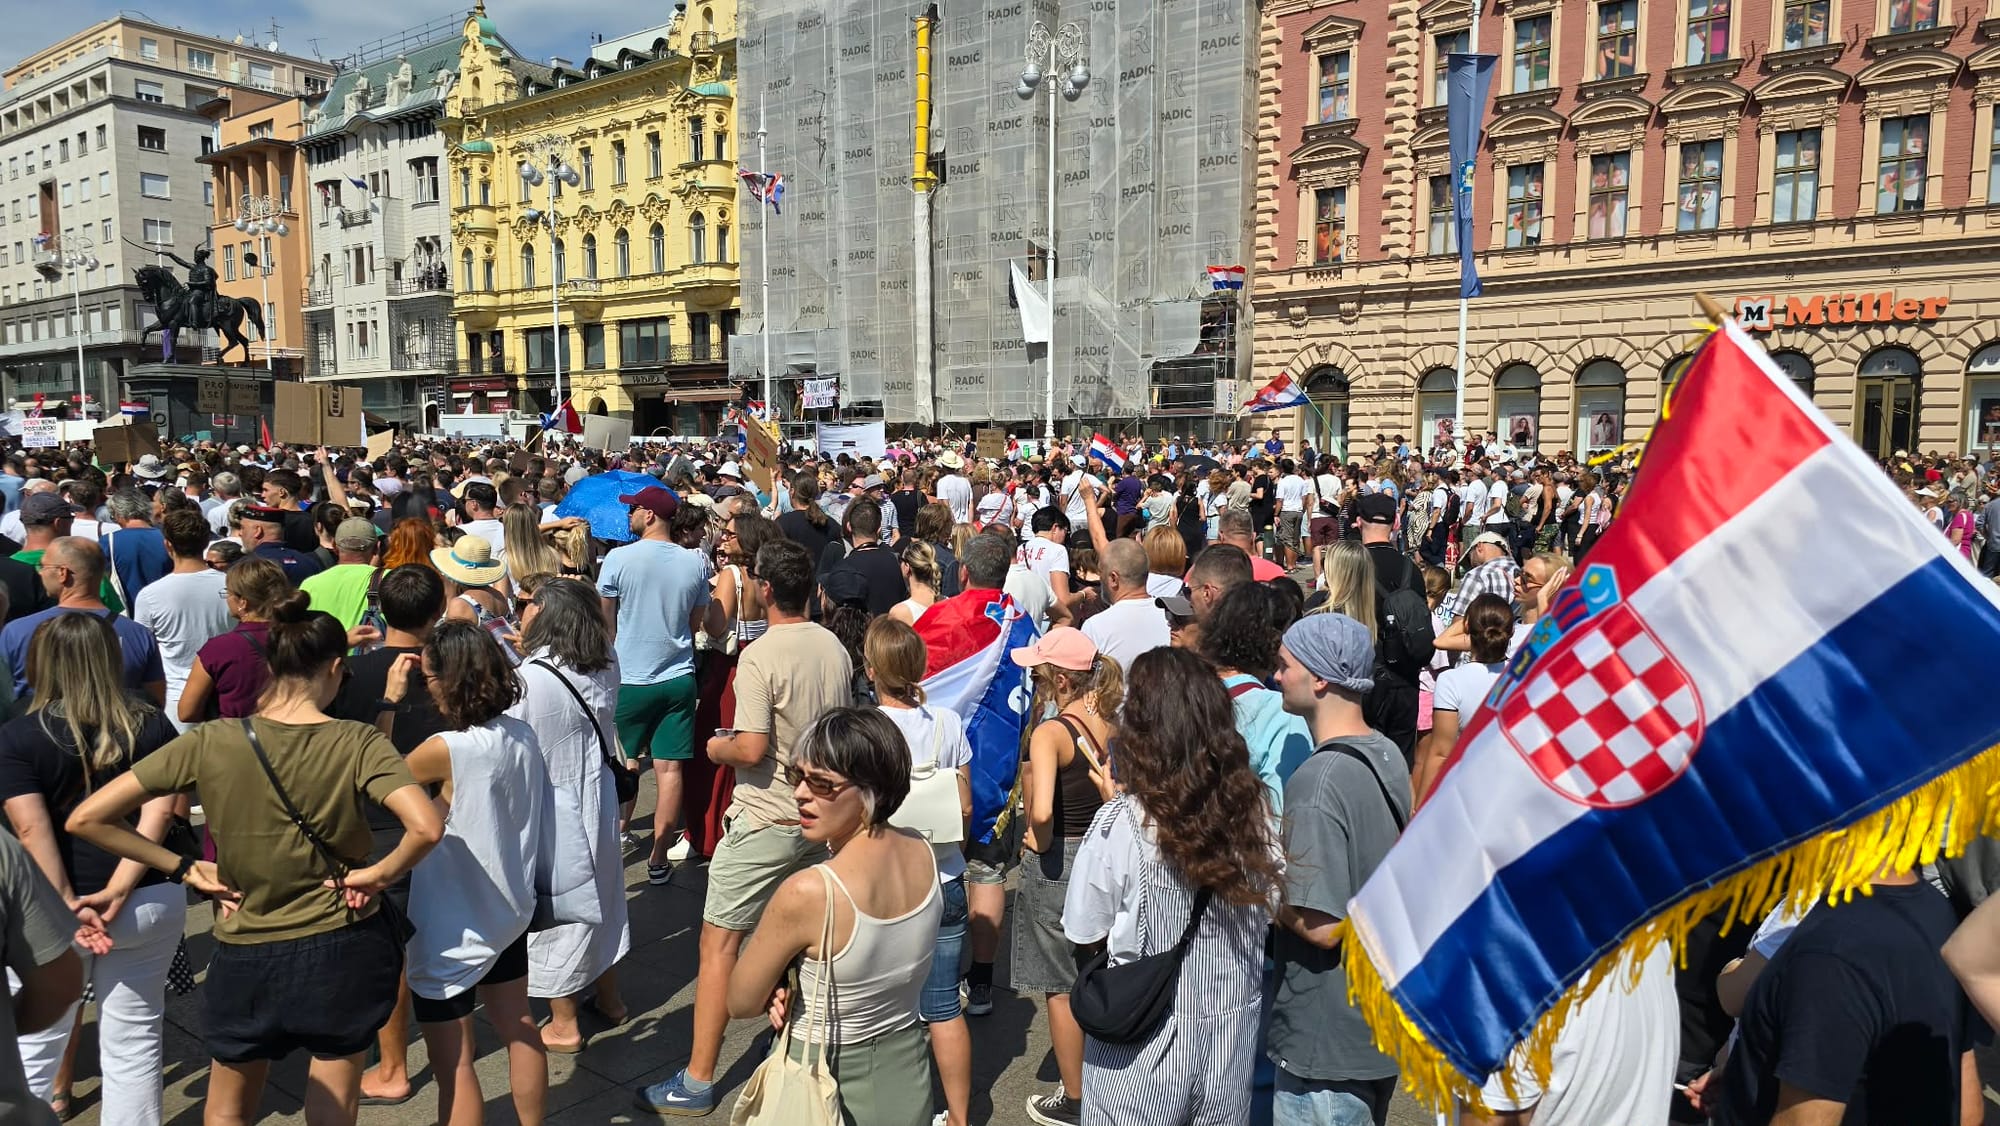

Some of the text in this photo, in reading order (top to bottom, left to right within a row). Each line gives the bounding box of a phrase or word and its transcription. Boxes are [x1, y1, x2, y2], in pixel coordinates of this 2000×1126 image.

[848, 10, 865, 36] R
[955, 17, 972, 46] R
[882, 35, 899, 62] R
[1129, 25, 1150, 57] R
[997, 81, 1016, 110] R
[1092, 78, 1108, 106] R
[1166, 69, 1185, 100] R
[850, 114, 868, 140] R
[957, 127, 975, 154] R
[1209, 115, 1232, 145] R
[884, 141, 901, 167] R
[1073, 131, 1090, 160] R
[1131, 145, 1149, 175] R
[1064, 170, 1090, 183] RADI
[998, 193, 1018, 222] R
[1089, 192, 1107, 221] R
[1166, 185, 1187, 216] R
[854, 216, 871, 241] R
[887, 245, 902, 270] R
[959, 235, 976, 262] R
[1209, 231, 1231, 258] R
[1785, 292, 1949, 325] Müller
